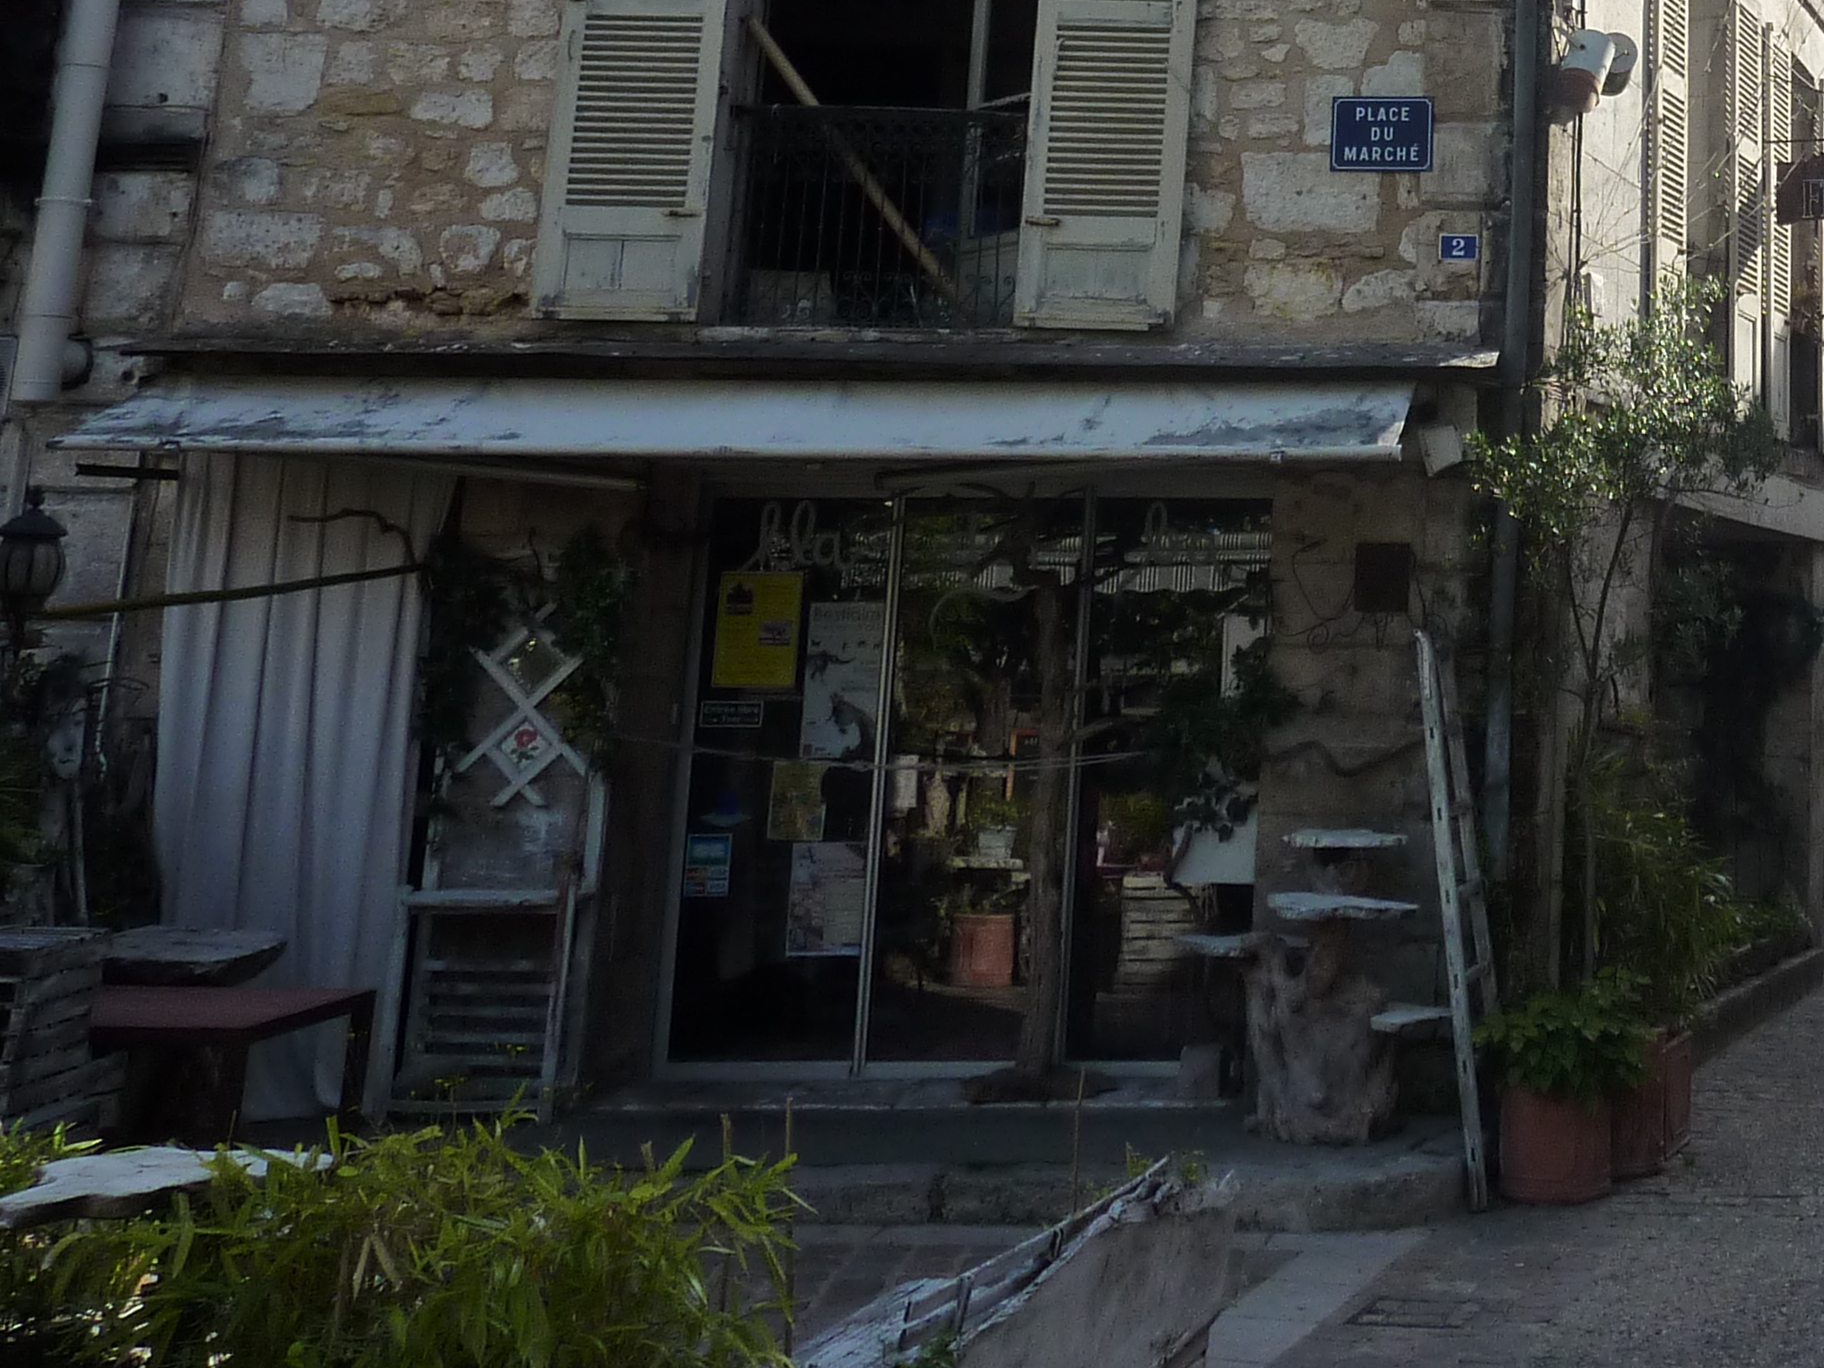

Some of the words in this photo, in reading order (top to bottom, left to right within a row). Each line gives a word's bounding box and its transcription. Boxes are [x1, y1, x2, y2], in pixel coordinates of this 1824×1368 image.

[1355, 107, 1411, 122] PLACE
[1370, 127, 1395, 142] DU
[1343, 143, 1420, 162] MARCHÉ
[1451, 238, 1466, 256] 2
